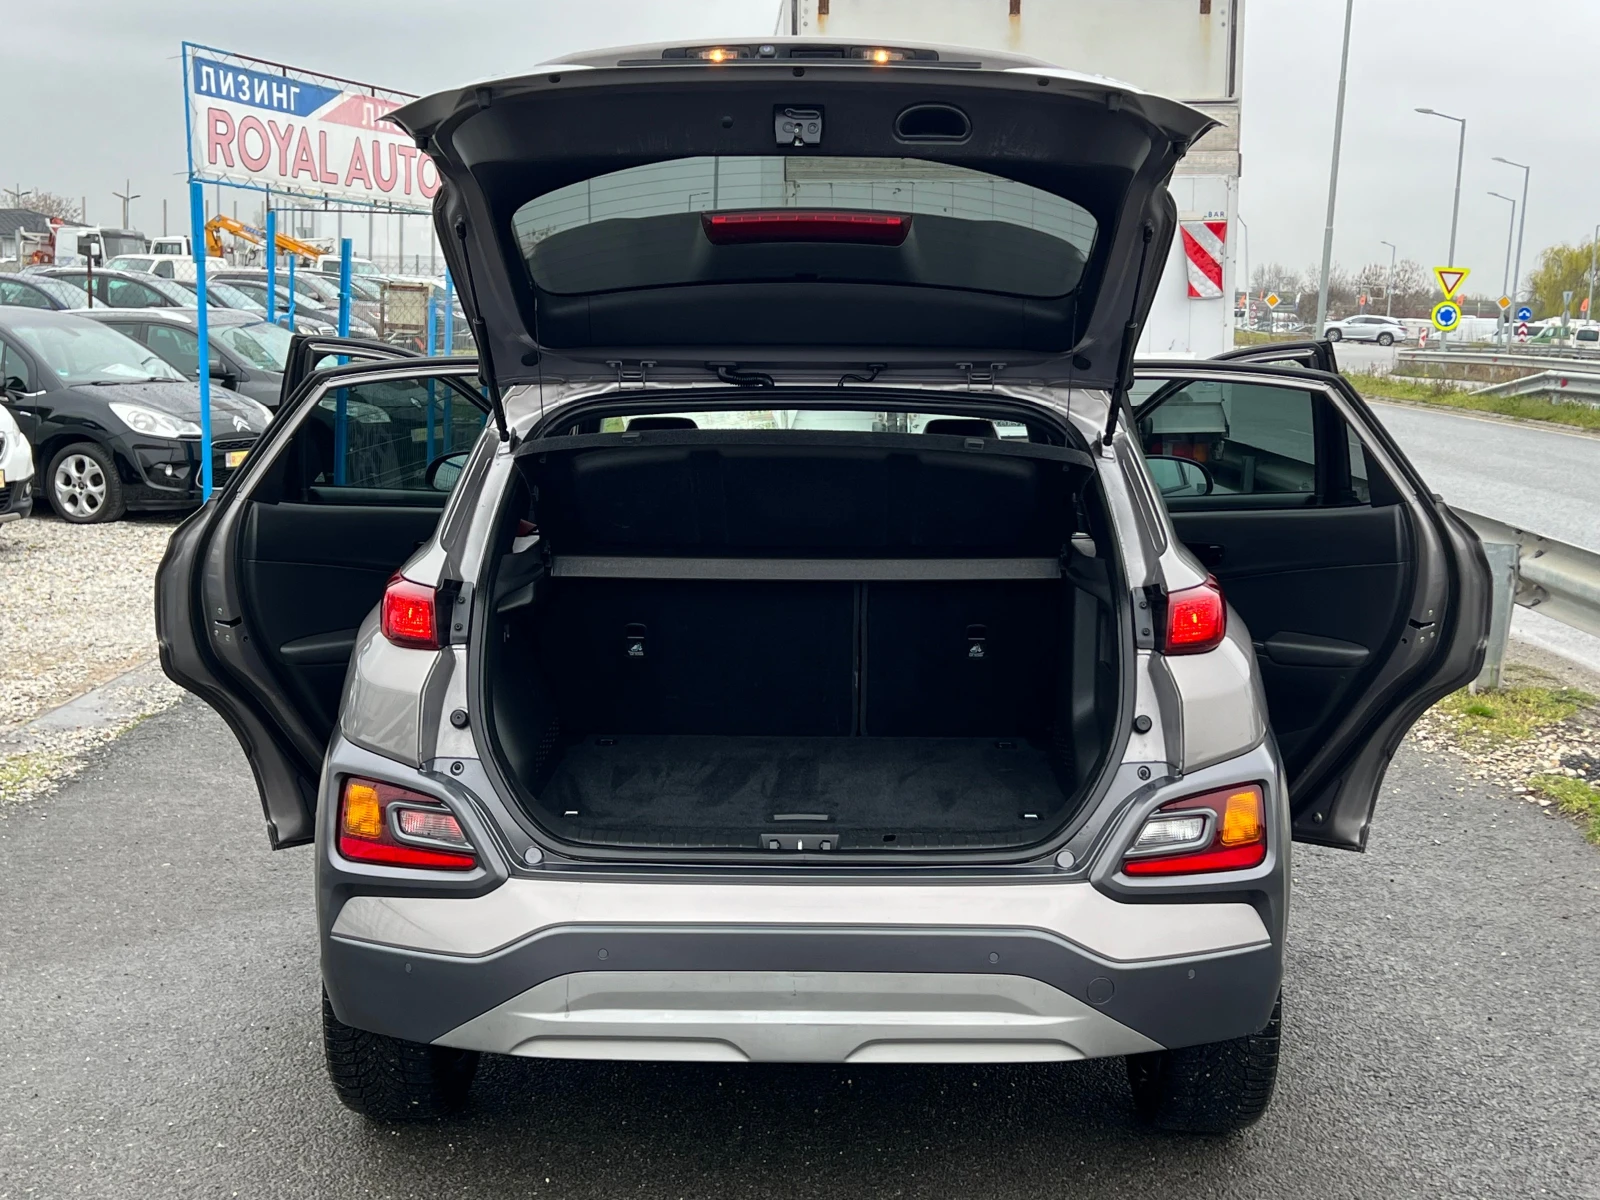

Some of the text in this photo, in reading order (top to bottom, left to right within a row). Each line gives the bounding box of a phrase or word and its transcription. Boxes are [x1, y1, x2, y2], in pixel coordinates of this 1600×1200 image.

[201, 65, 300, 111] ЛИЗИНГ
[208, 107, 442, 199] ROYAL AUTO
